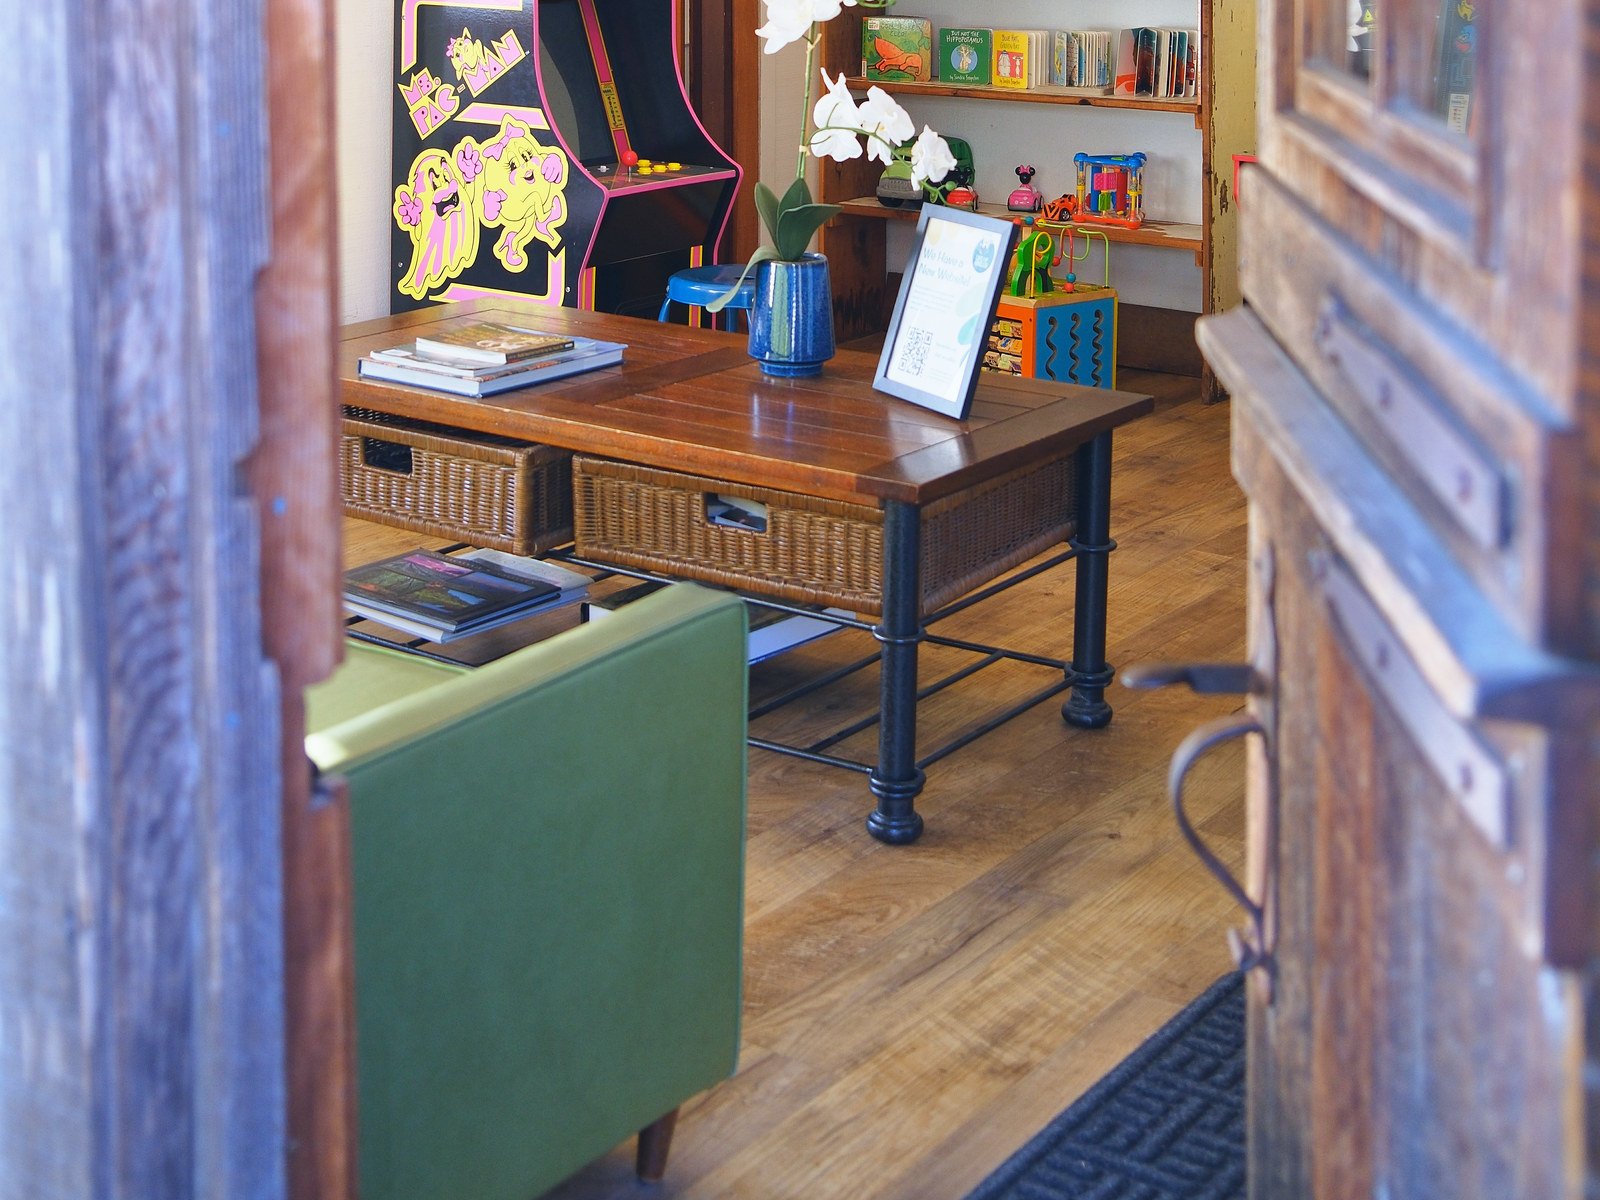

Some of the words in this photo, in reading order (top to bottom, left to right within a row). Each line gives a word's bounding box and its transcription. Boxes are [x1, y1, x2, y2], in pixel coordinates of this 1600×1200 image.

[946, 35, 983, 44] HIPPOPOTAMUS
[398, 67, 441, 109] MS.
[409, 29, 526, 140] PAC-MAN
